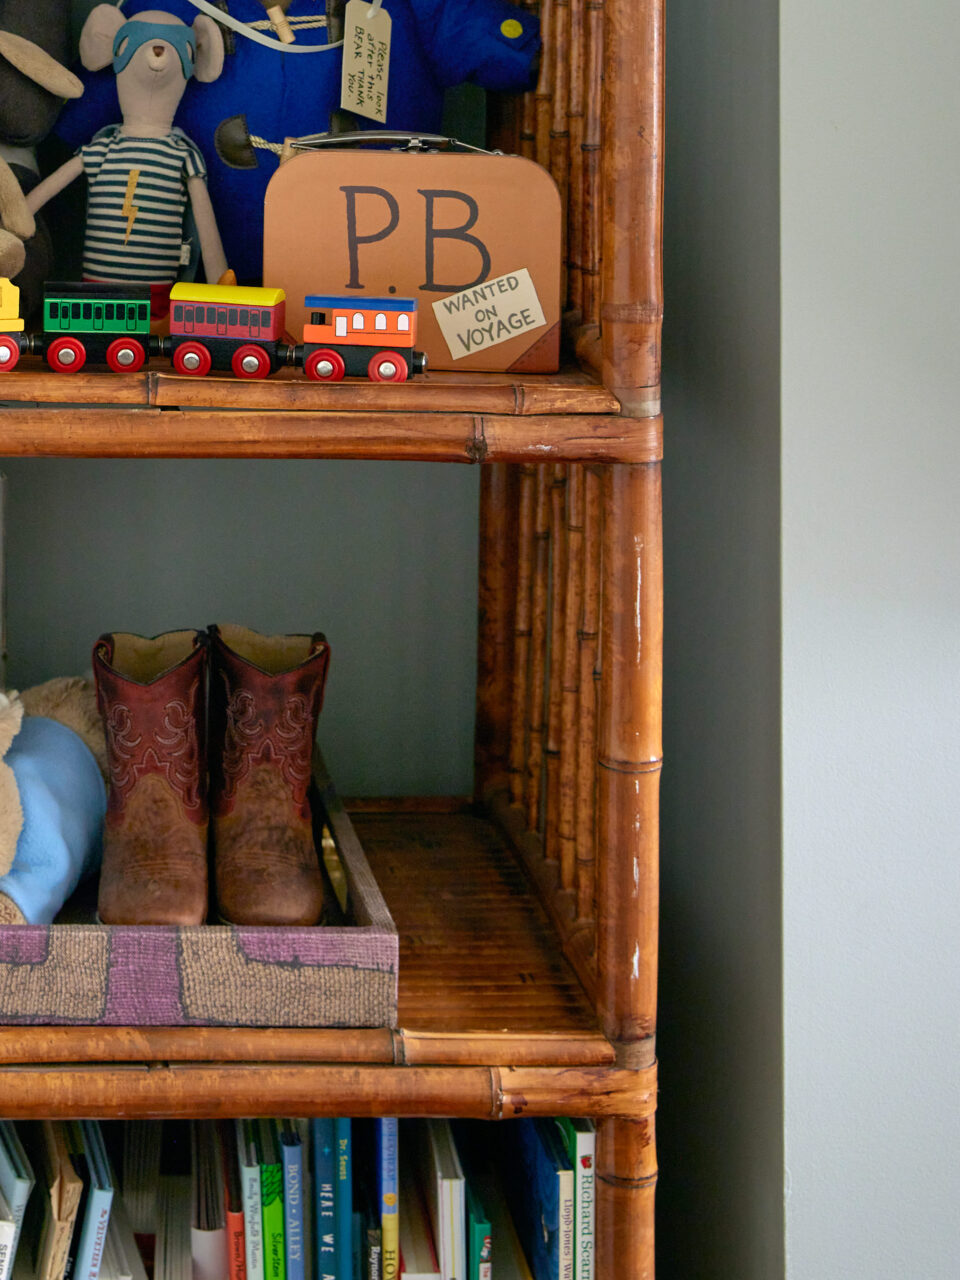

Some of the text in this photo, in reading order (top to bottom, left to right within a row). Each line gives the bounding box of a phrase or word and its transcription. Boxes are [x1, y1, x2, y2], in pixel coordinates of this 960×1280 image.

[353, 25, 365, 108] BEAR THANK
[366, 33, 375, 102] after this
[375, 41, 387, 117] Please look
[442, 275, 519, 315] WANTED
[474, 305, 498, 323] ON
[456, 308, 536, 352] VOYAGE
[339, 1139, 348, 1180] Dr. Seuss
[288, 1164, 301, 1261] BOND ALLEY
[581, 1174, 593, 1236] Richard
[321, 1233, 334, 1252] WE
